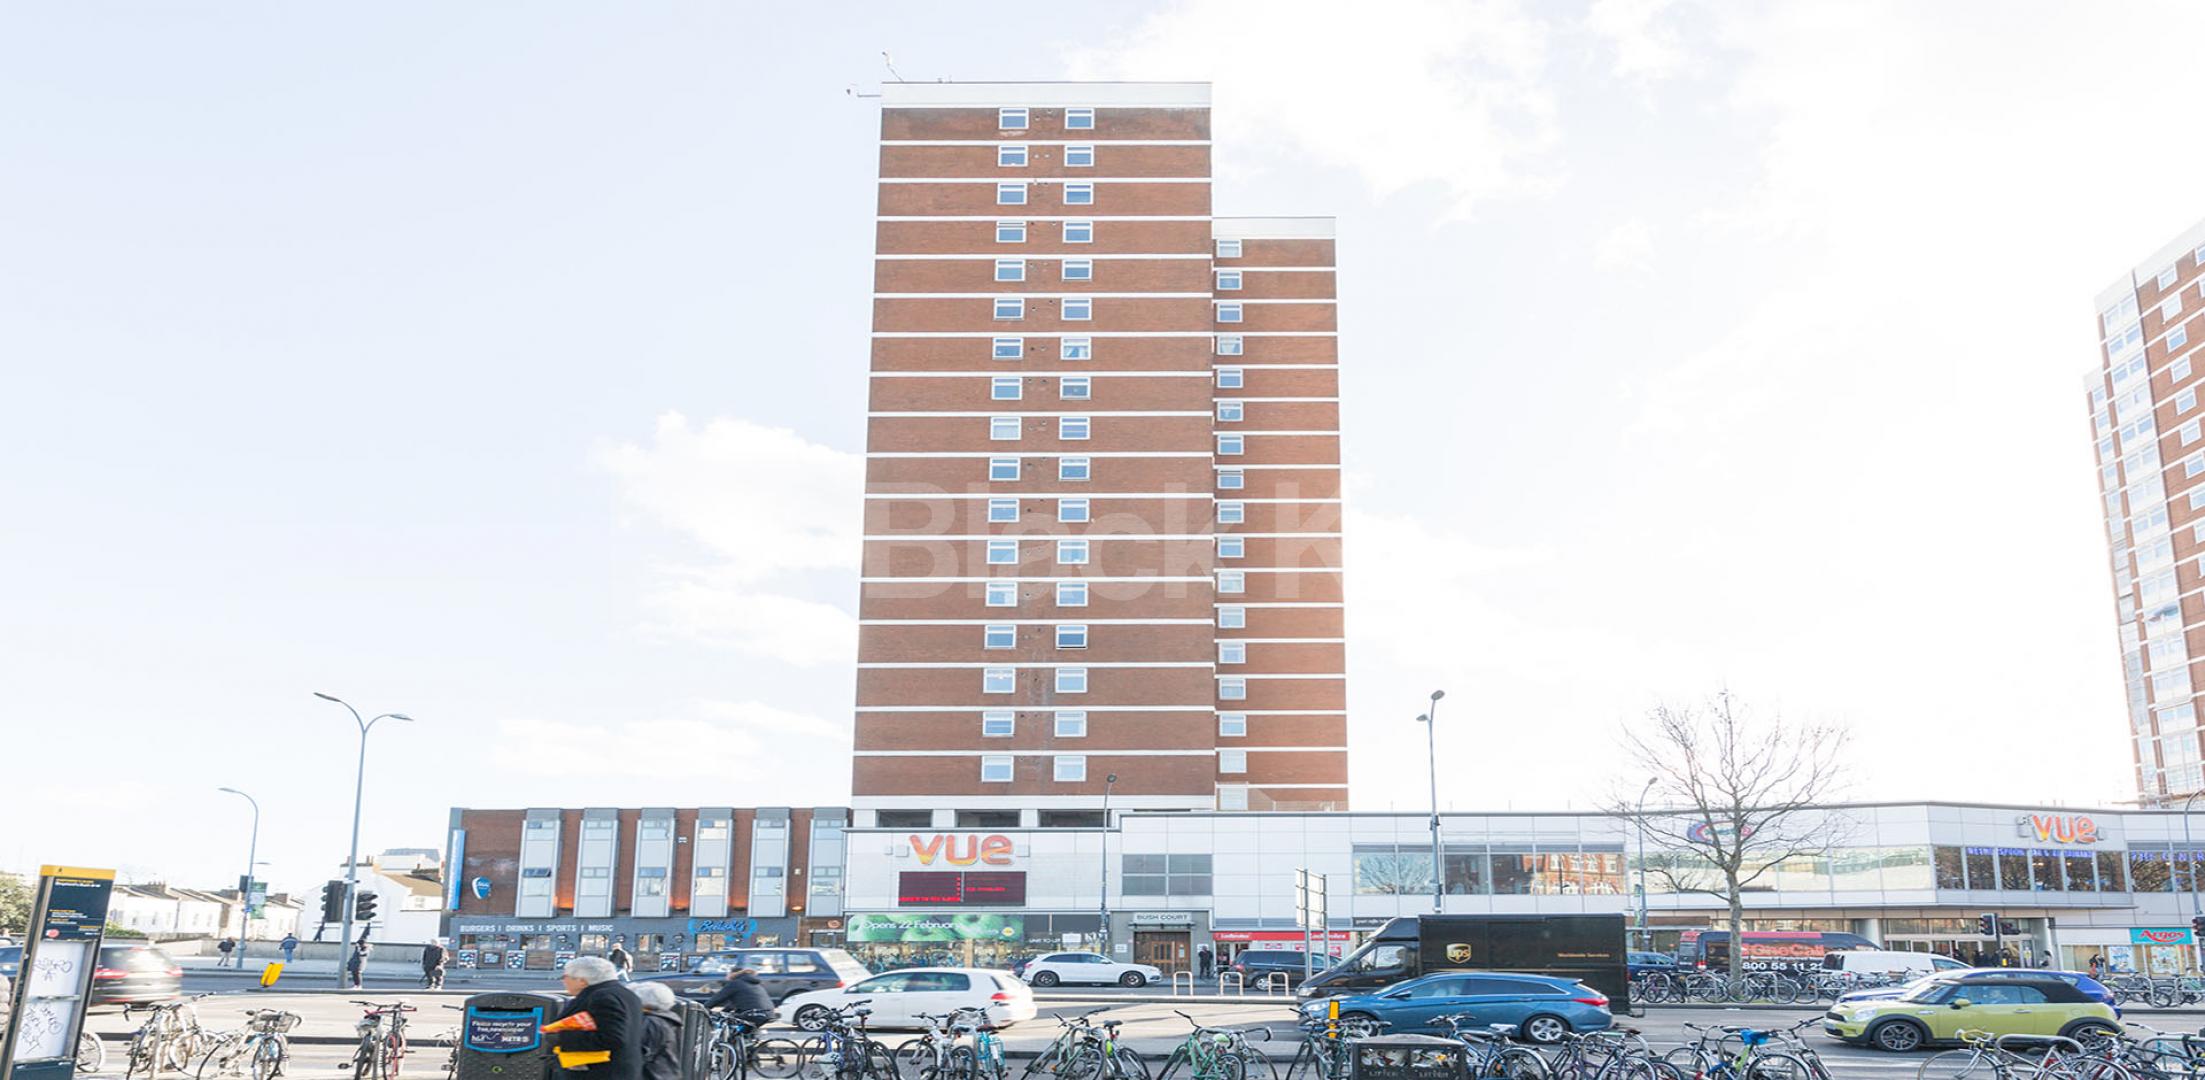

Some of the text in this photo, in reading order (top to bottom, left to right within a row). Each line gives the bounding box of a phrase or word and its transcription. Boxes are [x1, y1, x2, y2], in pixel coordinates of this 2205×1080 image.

[460, 924, 614, 932] BURGERS DRINKS SPORTS MUSIC
[862, 921, 896, 930] Opens
[898, 920, 909, 929] 22
[2140, 929, 2185, 941] Argos
[1450, 949, 1471, 961] ups
[1771, 962, 1787, 971] 55
